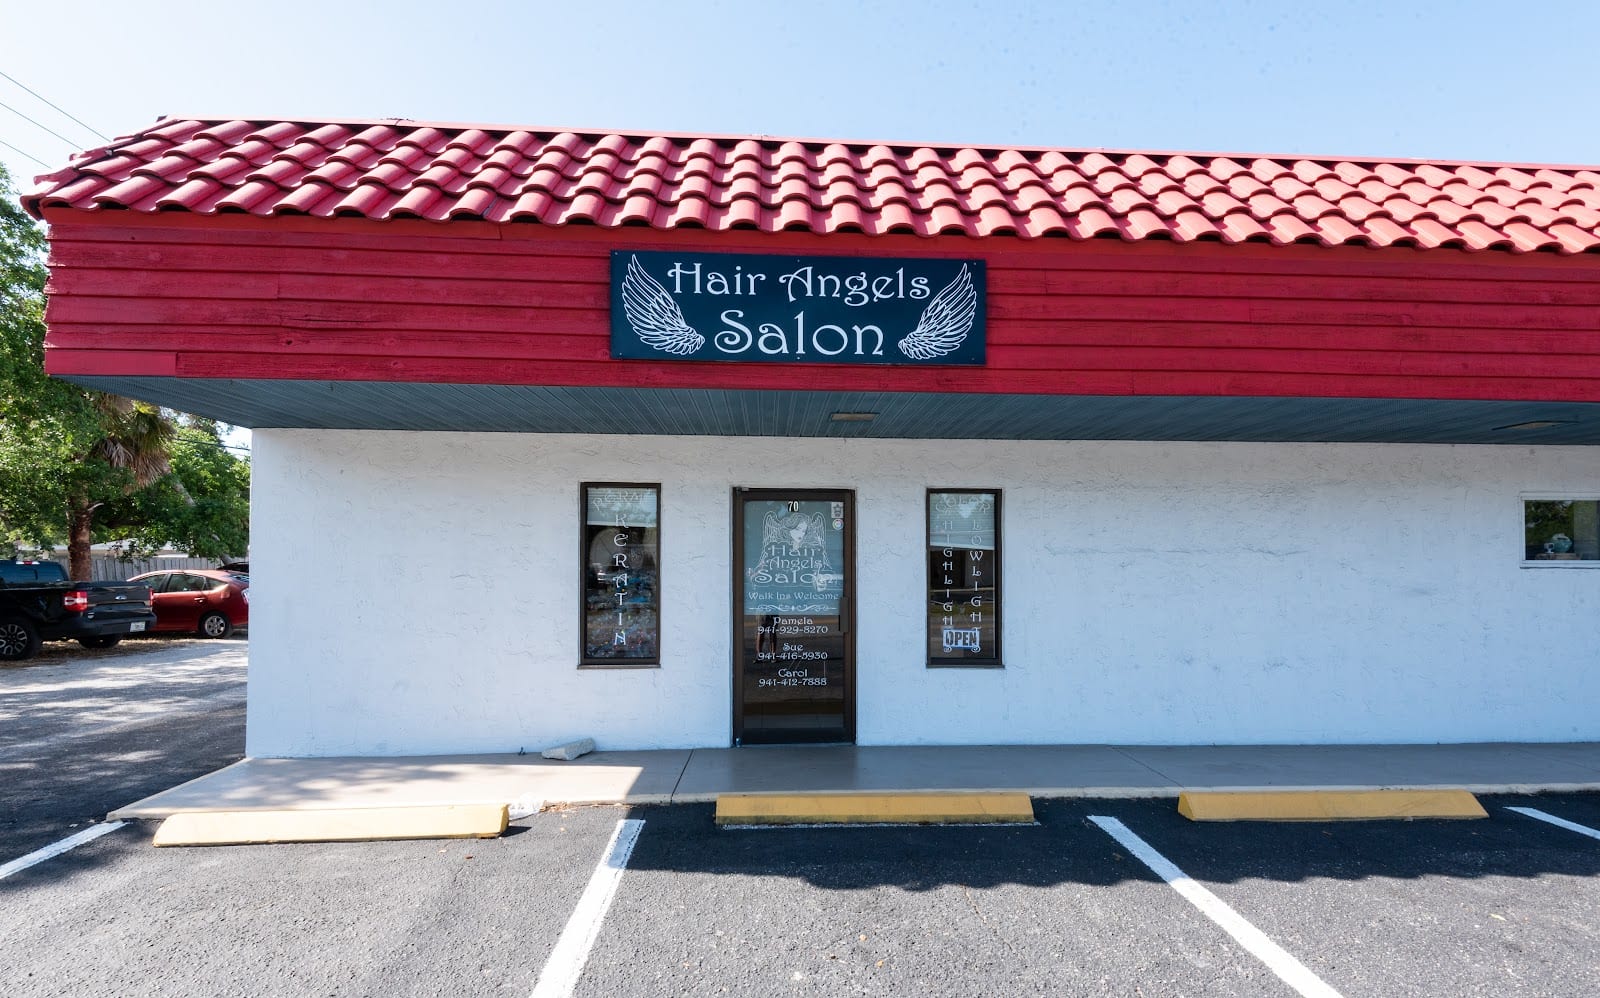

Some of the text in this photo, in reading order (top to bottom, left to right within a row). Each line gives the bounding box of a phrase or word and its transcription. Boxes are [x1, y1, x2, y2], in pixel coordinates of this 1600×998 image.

[668, 262, 931, 306] Hair Angels
[714, 309, 884, 356] Salon
[787, 501, 799, 512] 70
[767, 544, 821, 557] Hair
[766, 556, 822, 571] Angels
[612, 513, 629, 646] KERATIN
[748, 592, 774, 600] Walk
[794, 592, 839, 600] Welcome
[773, 616, 814, 626] Pamela
[757, 626, 828, 635] 941-929-8270
[945, 631, 977, 646] OPEN
[782, 642, 804, 652] Sue
[778, 668, 808, 678] Carol
